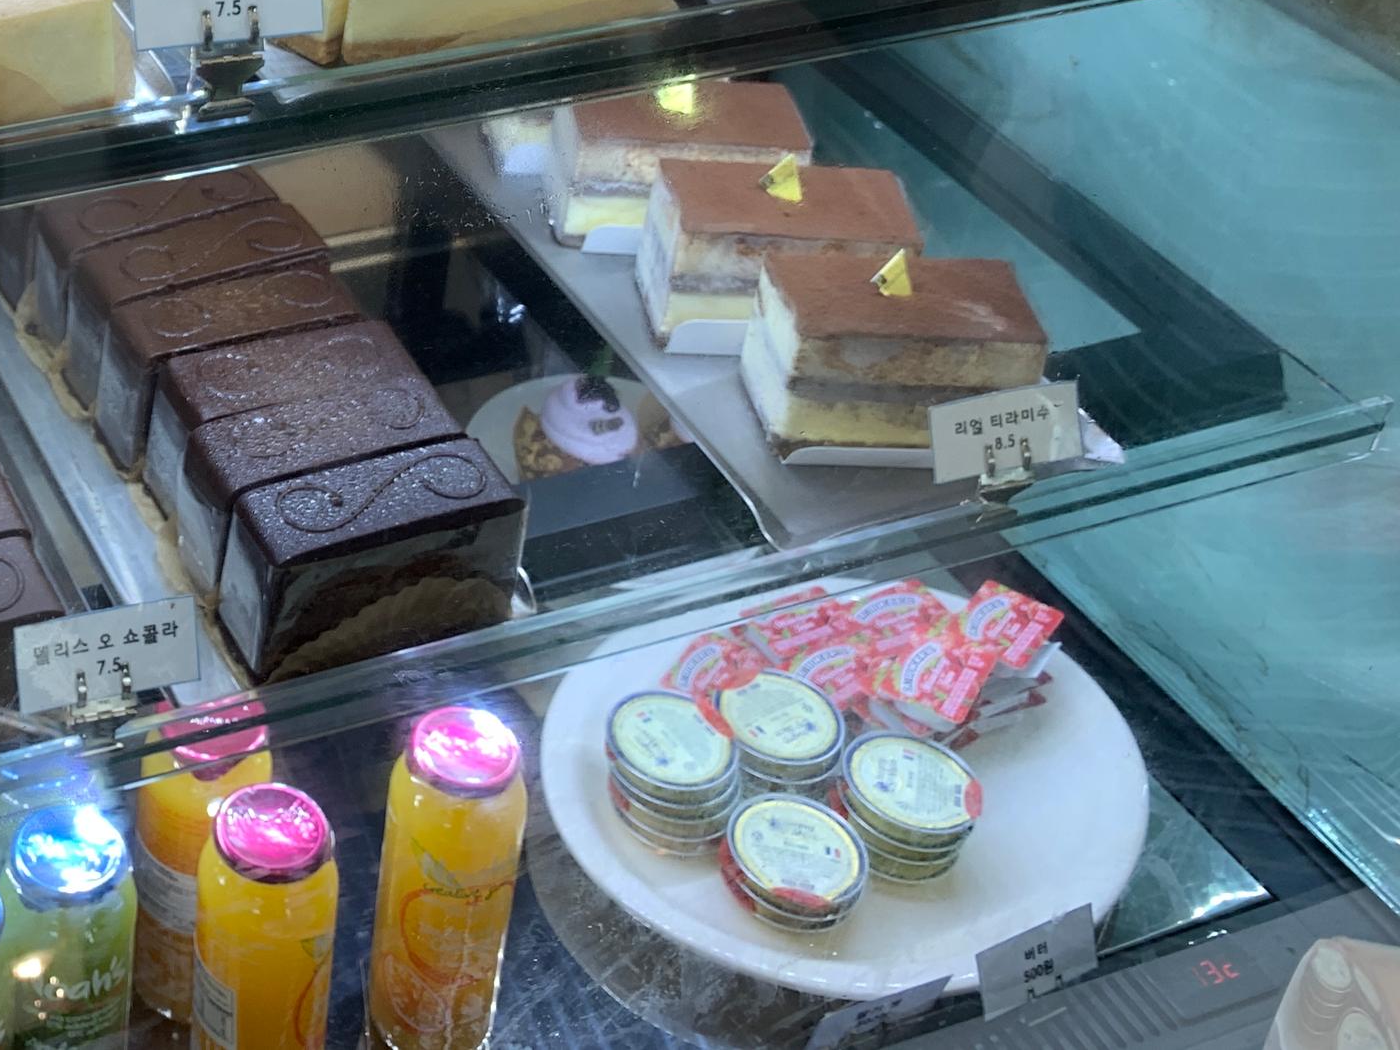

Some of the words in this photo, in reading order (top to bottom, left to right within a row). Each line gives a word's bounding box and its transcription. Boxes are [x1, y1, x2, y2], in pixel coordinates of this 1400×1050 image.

[215, 0, 242, 18] 7.5
[954, 418, 984, 436] 리얼
[990, 404, 1050, 428] 티라미수
[994, 434, 1016, 450] 8.5
[33, 637, 90, 667] 델리스
[97, 633, 115, 650] 오
[123, 620, 179, 646] 쇼콜라
[96, 657, 123, 676] 7.5
